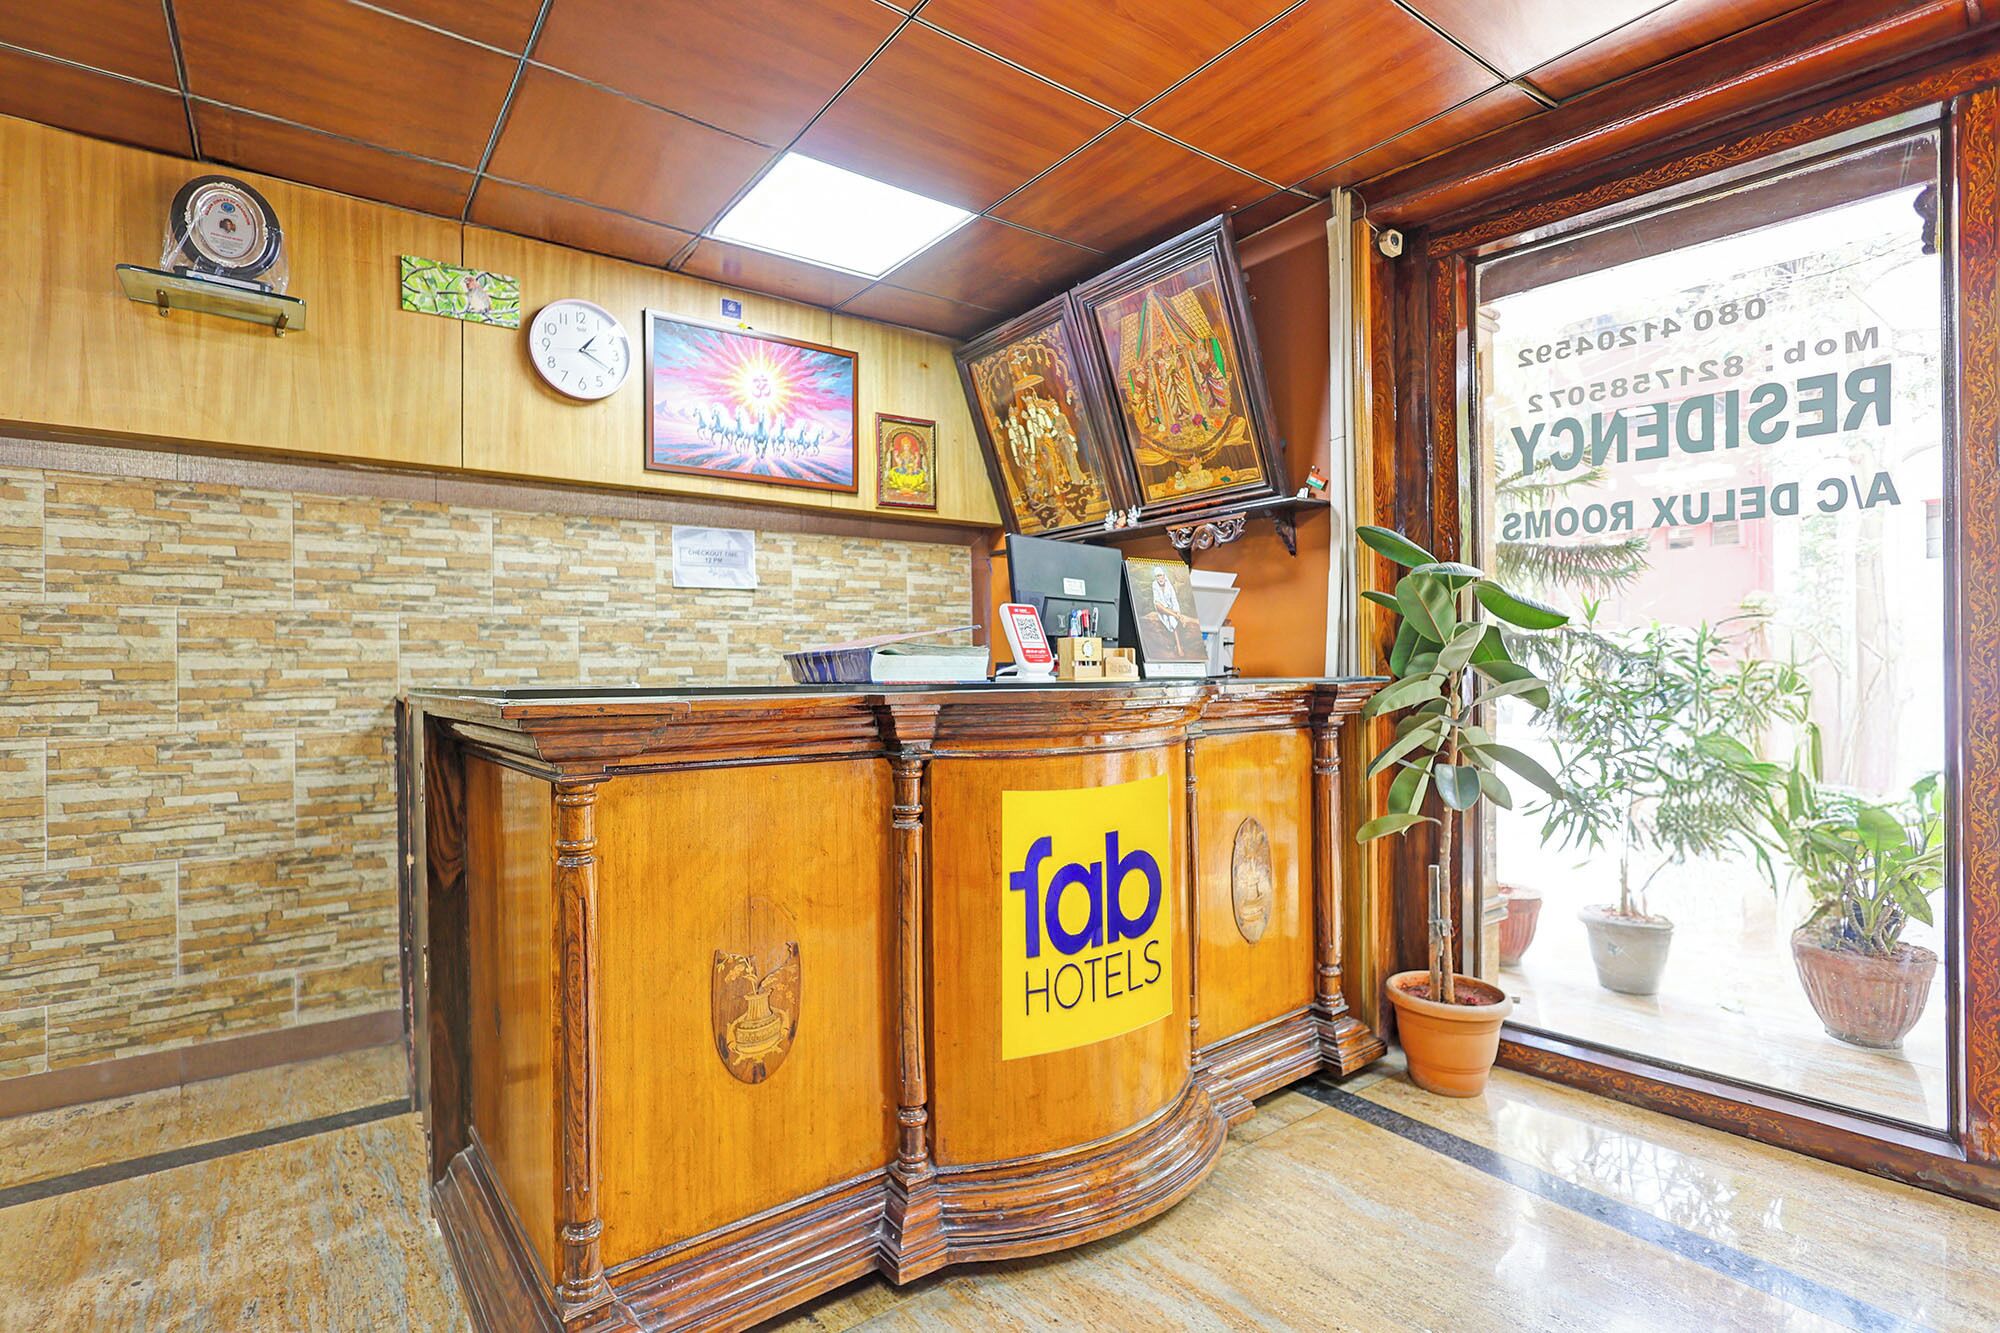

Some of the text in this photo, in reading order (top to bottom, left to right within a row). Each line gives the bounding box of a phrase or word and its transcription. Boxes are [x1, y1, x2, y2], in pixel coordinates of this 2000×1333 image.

[559, 312, 568, 325] 11
[576, 312, 586, 324] 12
[544, 321, 558, 336] 10
[541, 337, 551, 352] 9
[547, 356, 556, 369] 8
[613, 350, 620, 362] 3
[561, 369, 569, 383] 7
[607, 367, 615, 376] 4
[578, 377, 587, 391] 6
[595, 375, 604, 388] 5
[1009, 830, 1162, 959] fab
[1025, 939, 1162, 1016] HOTELS
